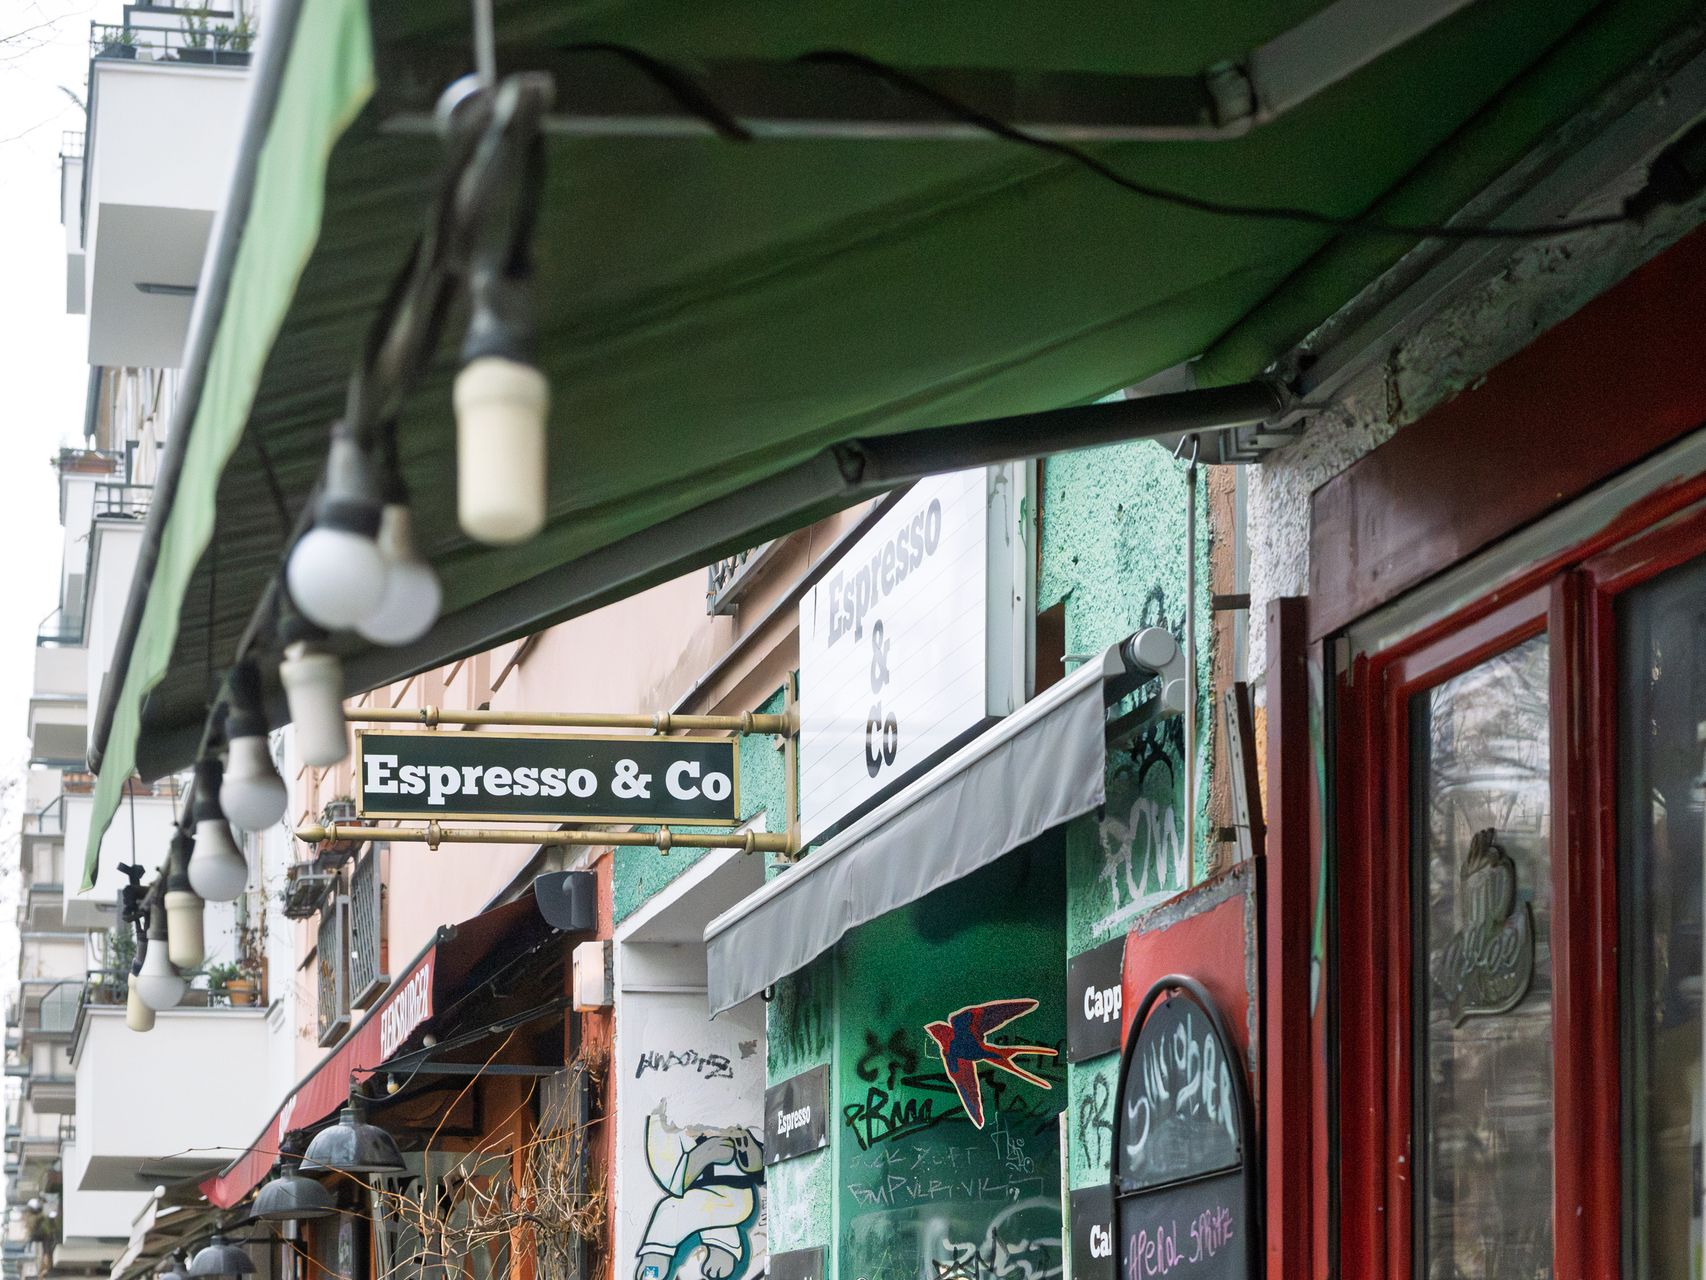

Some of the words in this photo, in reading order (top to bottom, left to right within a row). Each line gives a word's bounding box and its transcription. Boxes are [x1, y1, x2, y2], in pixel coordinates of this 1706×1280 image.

[827, 497, 942, 649] Espresso
[870, 618, 891, 695] &
[865, 700, 898, 779] Co
[363, 754, 598, 805] Espresso
[610, 758, 652, 799] &
[664, 760, 732, 801] Co
[1084, 984, 1122, 1024] Capp
[777, 1105, 811, 1138] Espresso
